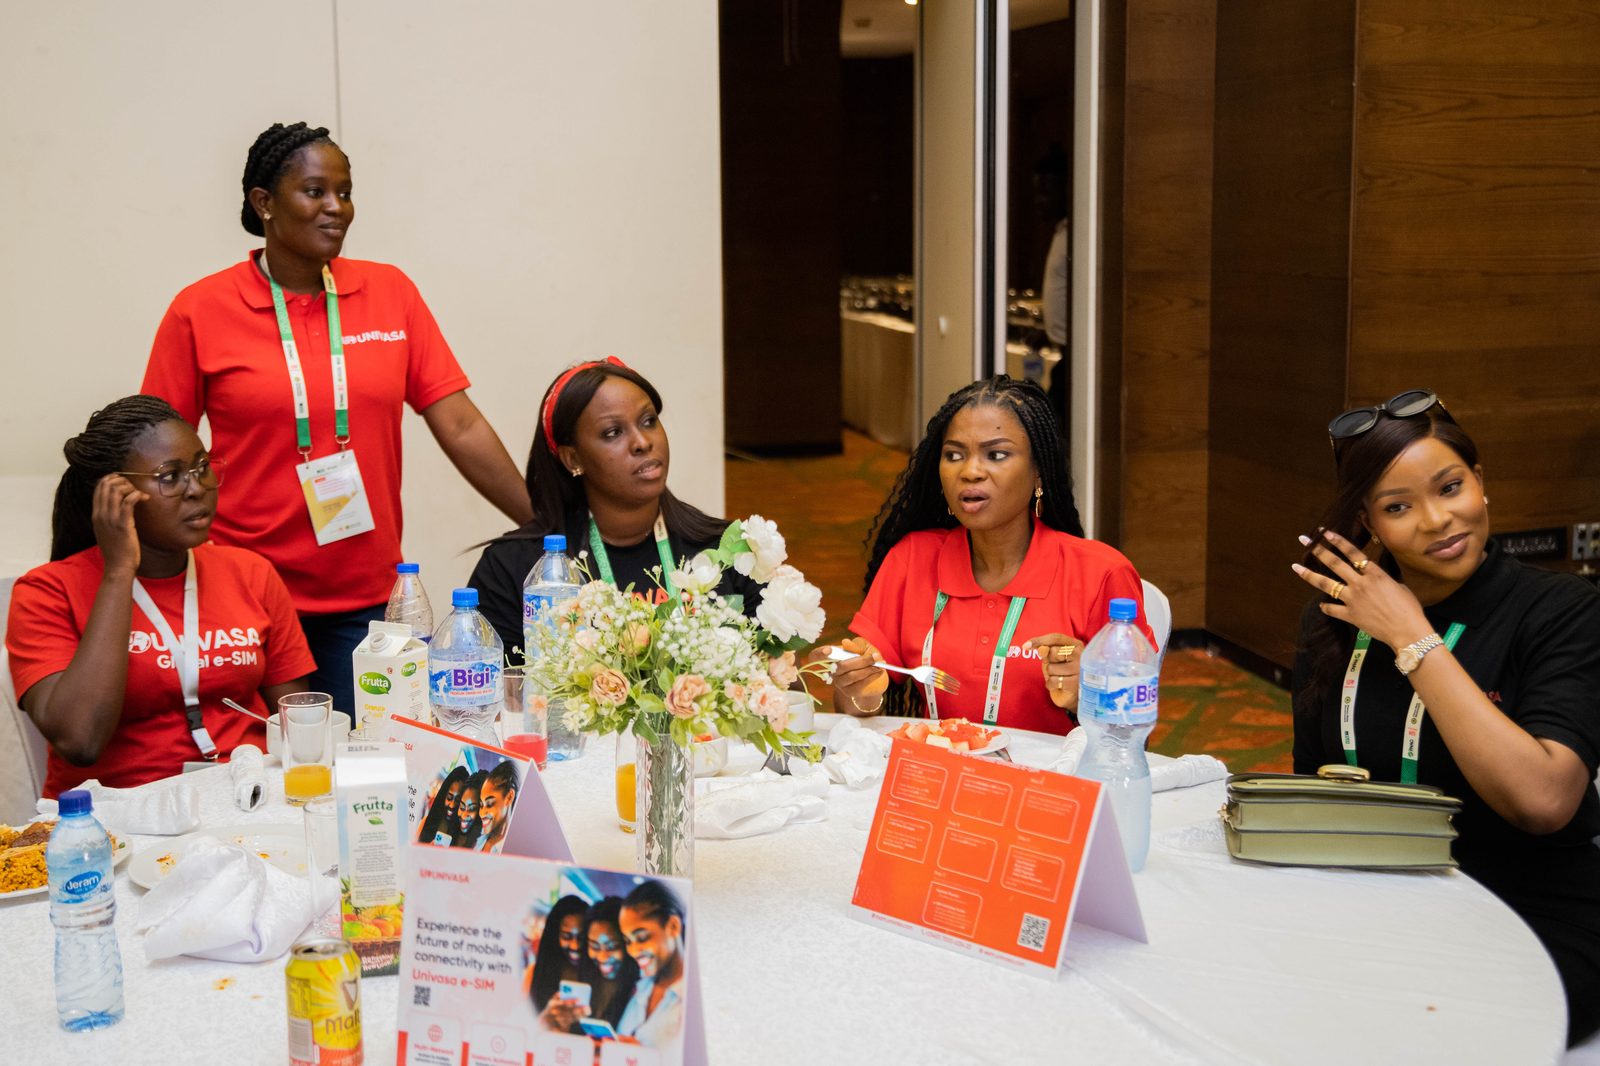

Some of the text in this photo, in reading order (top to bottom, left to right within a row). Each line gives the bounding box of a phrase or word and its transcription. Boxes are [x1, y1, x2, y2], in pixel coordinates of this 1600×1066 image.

[150, 627, 261, 652] UVASA
[157, 650, 258, 669] Glal e-SIM
[361, 675, 389, 688] Frutta
[453, 667, 490, 688] Bigi
[1136, 685, 1157, 702] Big
[352, 800, 394, 815] Frutta
[66, 875, 99, 890] Jeram
[417, 917, 502, 940] Experience the
[416, 933, 506, 956] future of mobile
[414, 951, 485, 973] connectivity
[487, 960, 512, 974] with
[412, 967, 495, 992] Univasa e-SIM
